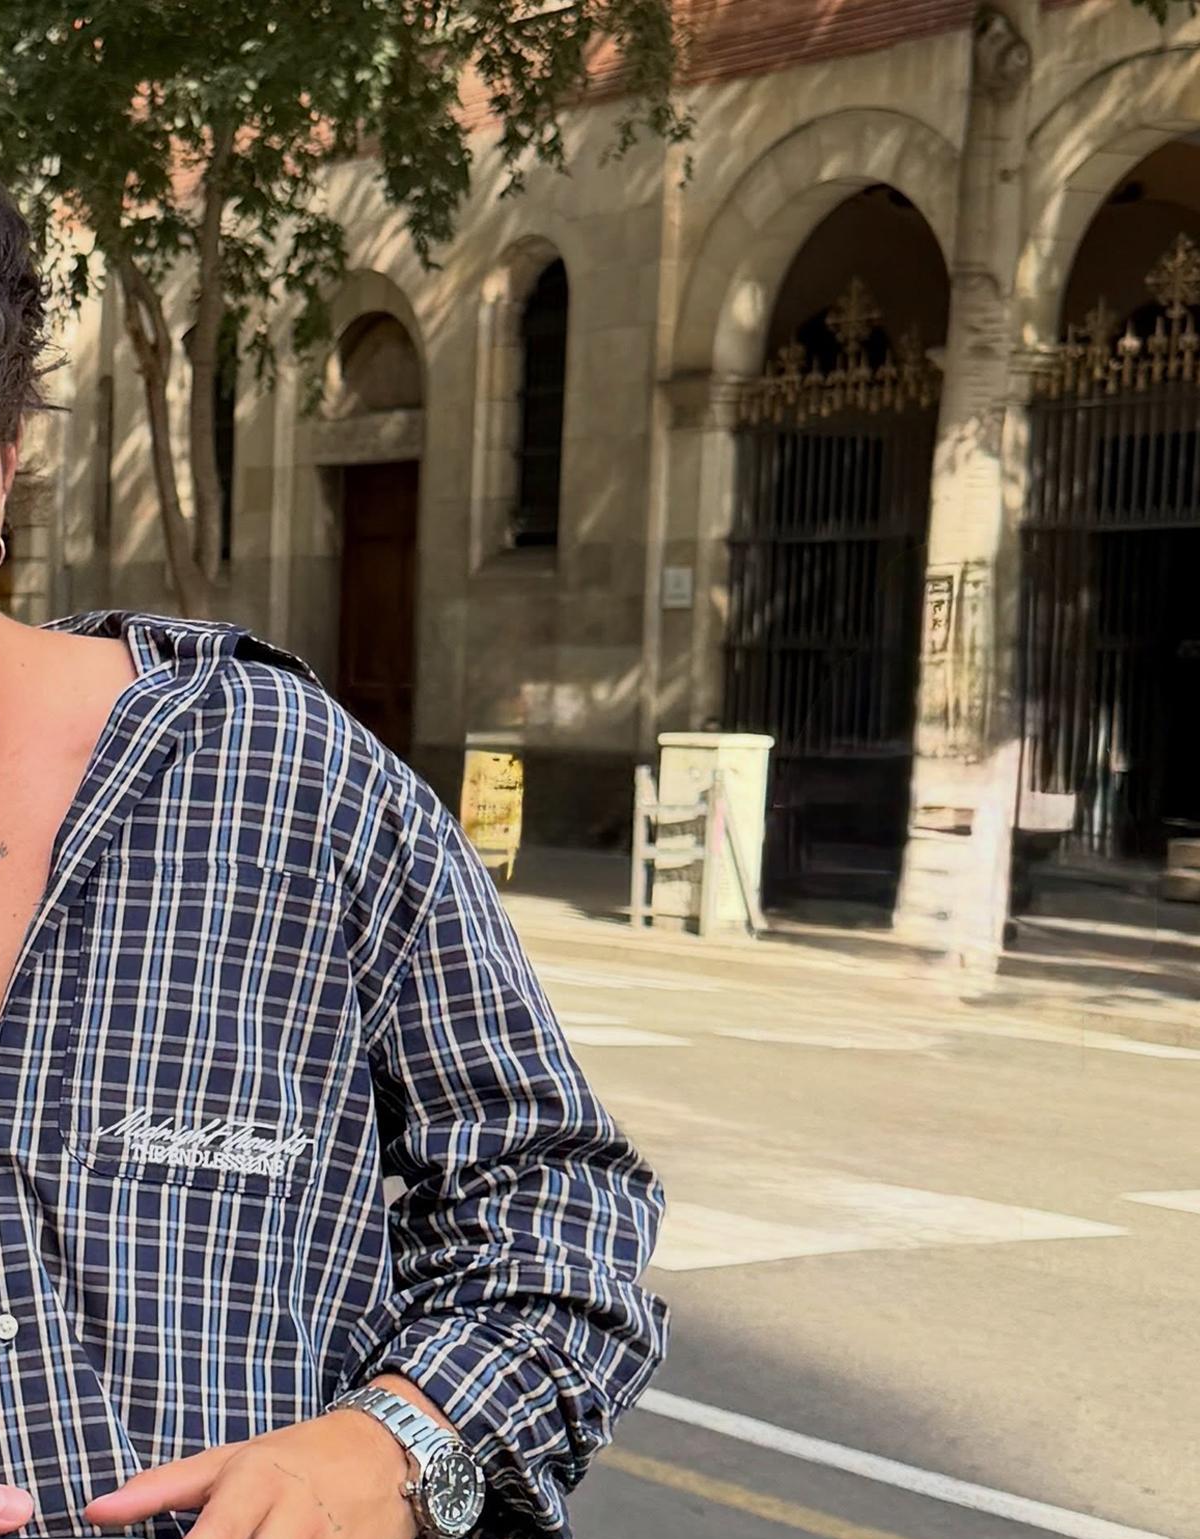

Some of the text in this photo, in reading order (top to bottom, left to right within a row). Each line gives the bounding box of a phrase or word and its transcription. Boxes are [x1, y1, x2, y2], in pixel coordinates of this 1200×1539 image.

[97, 1106, 231, 1156] Midnight
[131, 1144, 163, 1164] THE
[167, 1150, 243, 1173] ENDLESS
